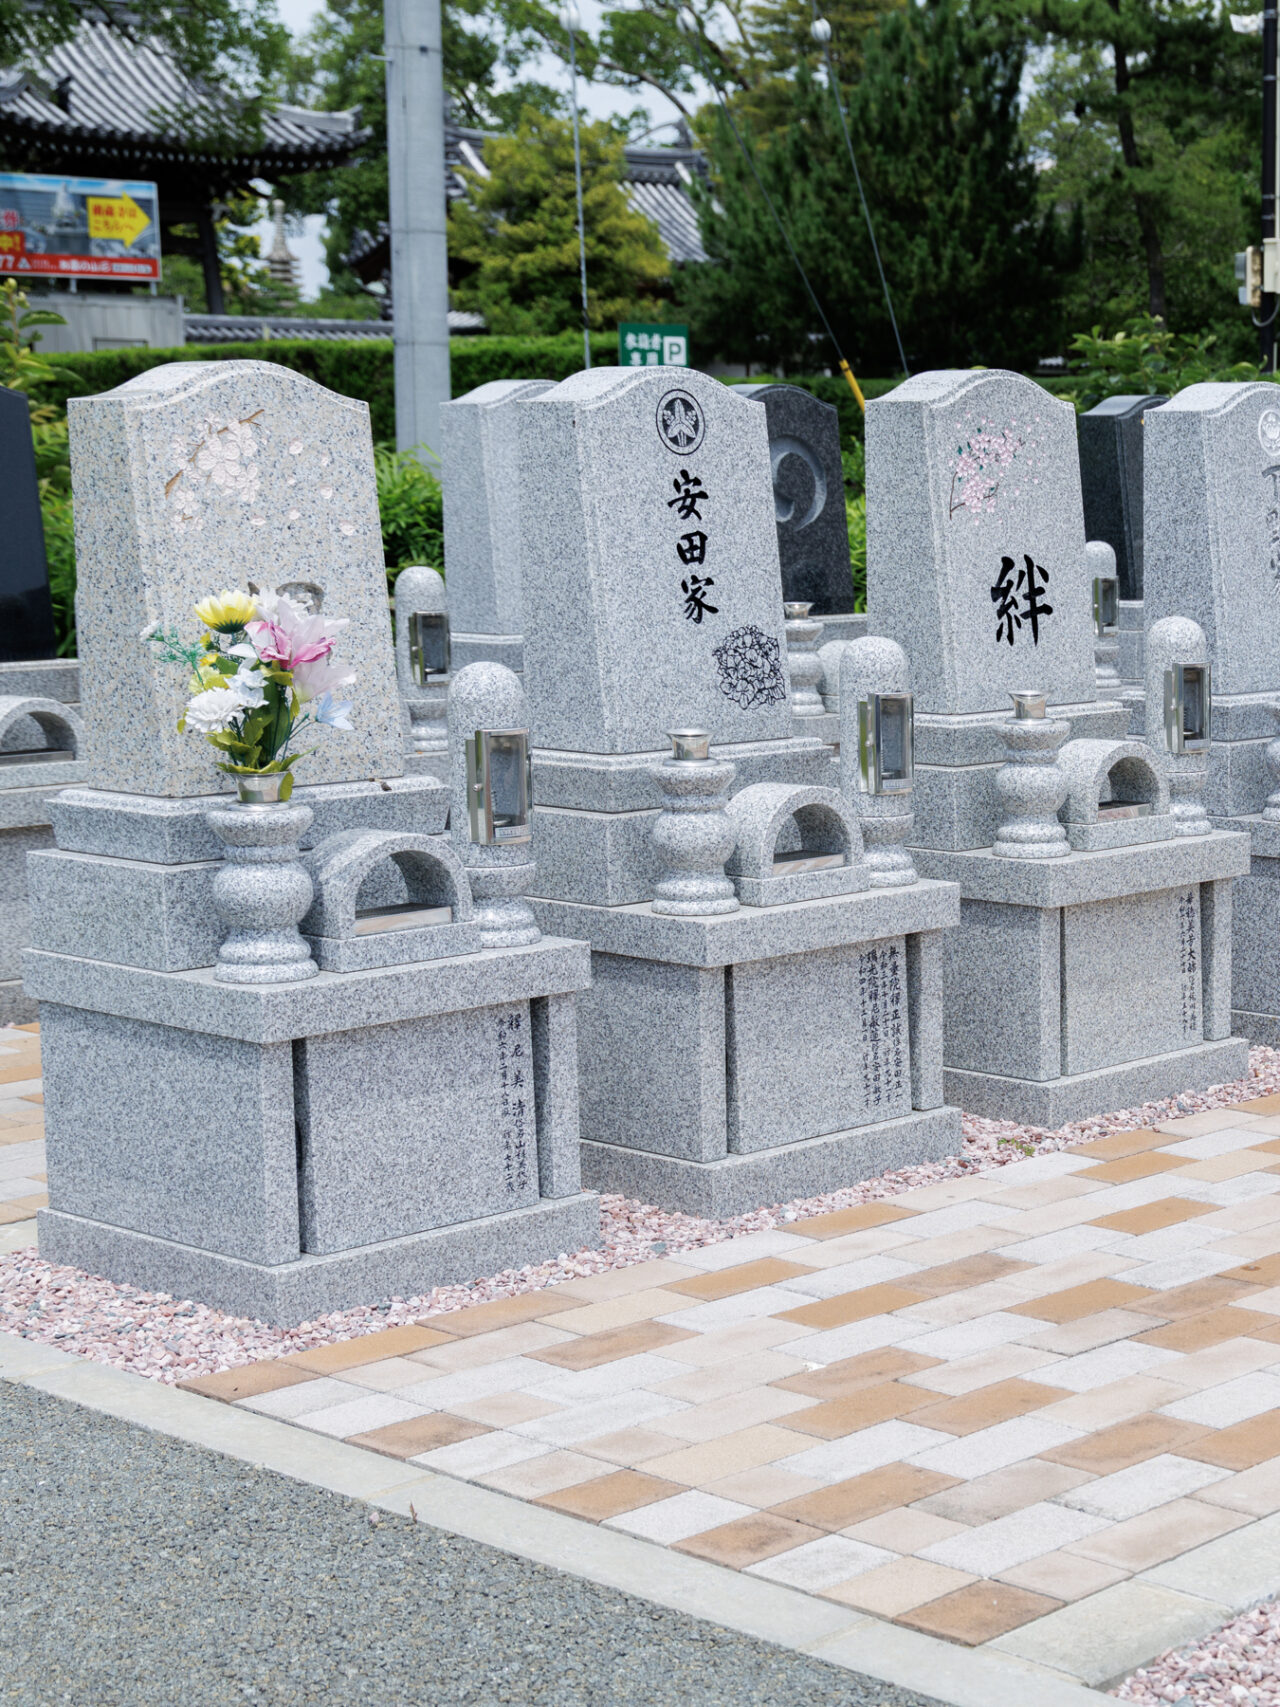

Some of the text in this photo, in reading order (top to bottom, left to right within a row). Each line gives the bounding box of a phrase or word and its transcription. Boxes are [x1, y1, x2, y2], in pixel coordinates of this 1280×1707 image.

[667, 469, 719, 624] 安田家
[991, 554, 1053, 646] 絆
